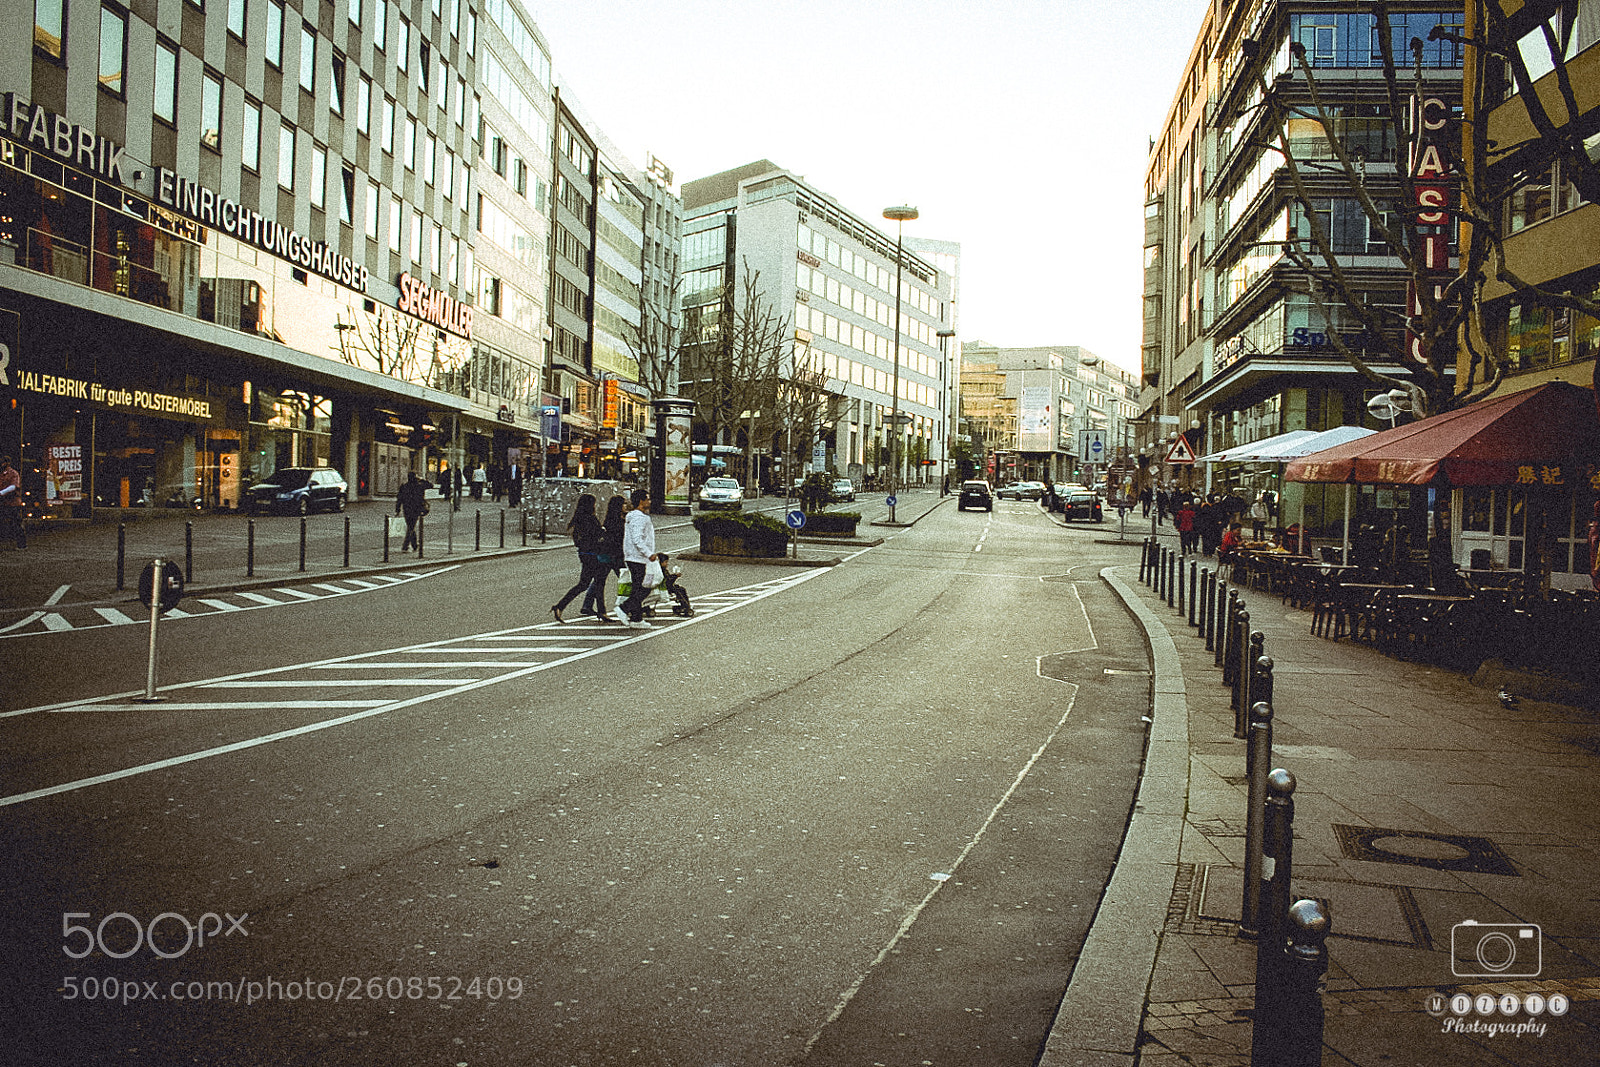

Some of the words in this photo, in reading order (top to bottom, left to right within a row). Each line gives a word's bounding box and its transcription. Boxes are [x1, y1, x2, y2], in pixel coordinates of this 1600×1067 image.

[0, 92, 125, 185] FABRIK
[158, 166, 370, 293] EINRICHTUNGSHÄUSER
[398, 270, 474, 339] SEGMÜLLER
[90, 382, 108, 403] für
[108, 388, 133, 407] gute
[133, 390, 212, 419] POLSTERMÖBEL
[52, 445, 82, 459] BESTE
[58, 459, 83, 473] PREIS
